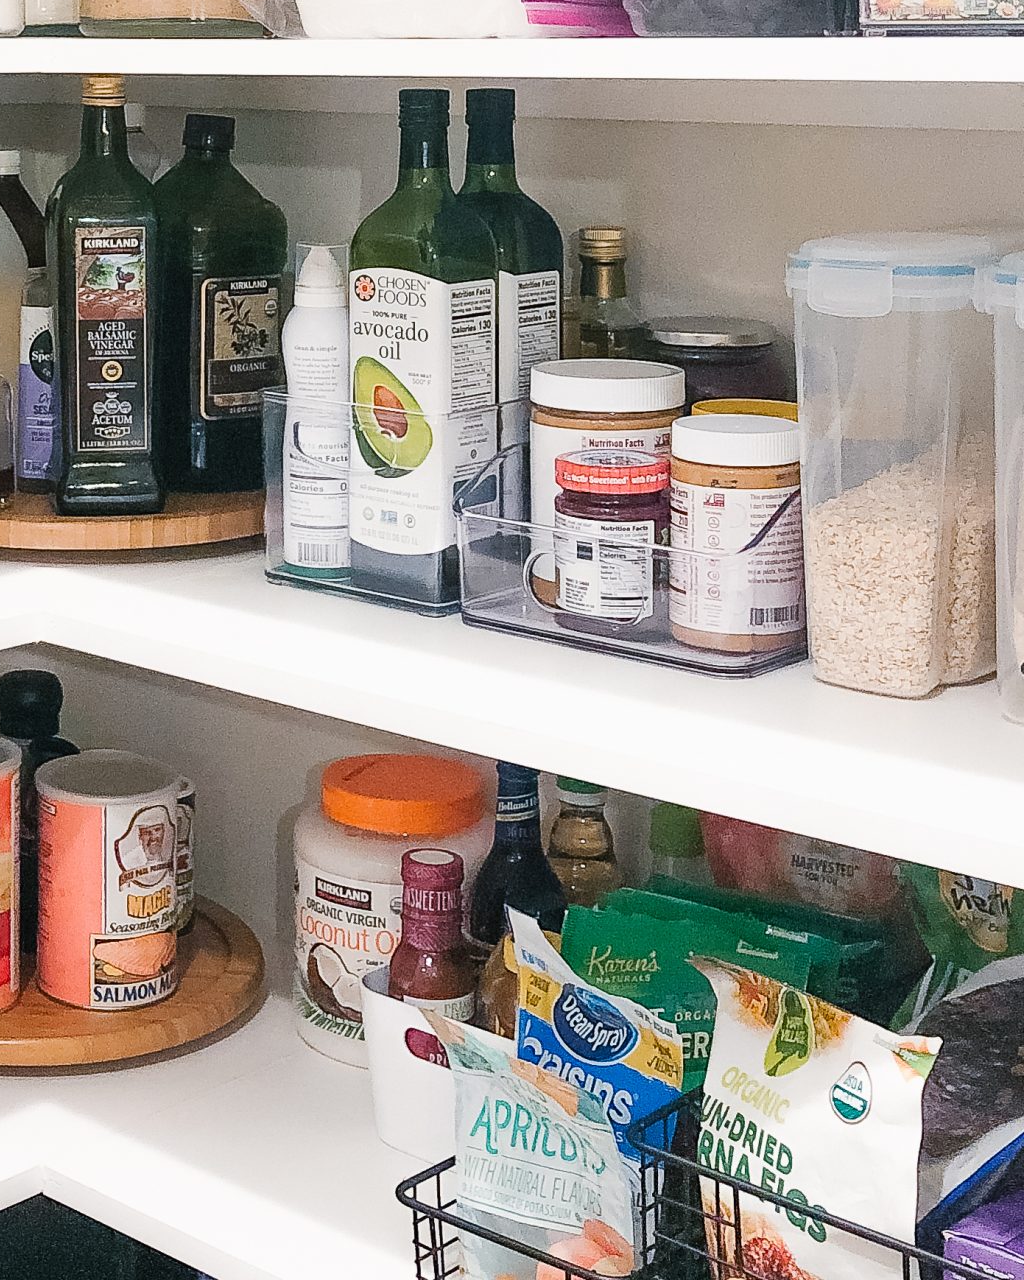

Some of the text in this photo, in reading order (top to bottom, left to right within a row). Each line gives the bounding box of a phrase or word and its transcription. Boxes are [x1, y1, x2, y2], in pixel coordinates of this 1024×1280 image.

[83, 238, 139, 249] KIRKLAND
[230, 279, 268, 290] KIRKLAND
[377, 276, 427, 291] CHOSEN
[518, 279, 556, 290] Nutrition Facts
[377, 290, 427, 307] FOODS
[451, 288, 491, 300] Nutrition Facts
[372, 310, 408, 320] 100% PURE
[97, 322, 126, 332] AGED
[353, 322, 429, 342] avocado
[451, 319, 492, 335] Calories 130
[87, 330, 137, 341] BALSAMIC
[89, 339, 135, 350] VINEGAR
[378, 341, 401, 360] oil
[229, 361, 267, 373] ORGANIC
[91, 413, 133, 425] ACETUM
[588, 438, 645, 448] Nutrition Facts
[289, 482, 347, 493] Calories 0
[316, 879, 370, 903] KIRKLAND
[127, 886, 172, 919] MAGIC
[306, 896, 387, 929] ORGANIC VIRGIN
[109, 915, 160, 934] Seasoning
[299, 905, 401, 955] Coconut Oi
[588, 945, 661, 976] Karen's
[595, 974, 651, 984] NATURALS
[92, 980, 158, 1003] SALMON
[562, 995, 627, 1053] Ocean Spray
[721, 1066, 791, 1124] ORGANIC
[463, 1153, 603, 1218] WITH NATURAL FLAVORS
